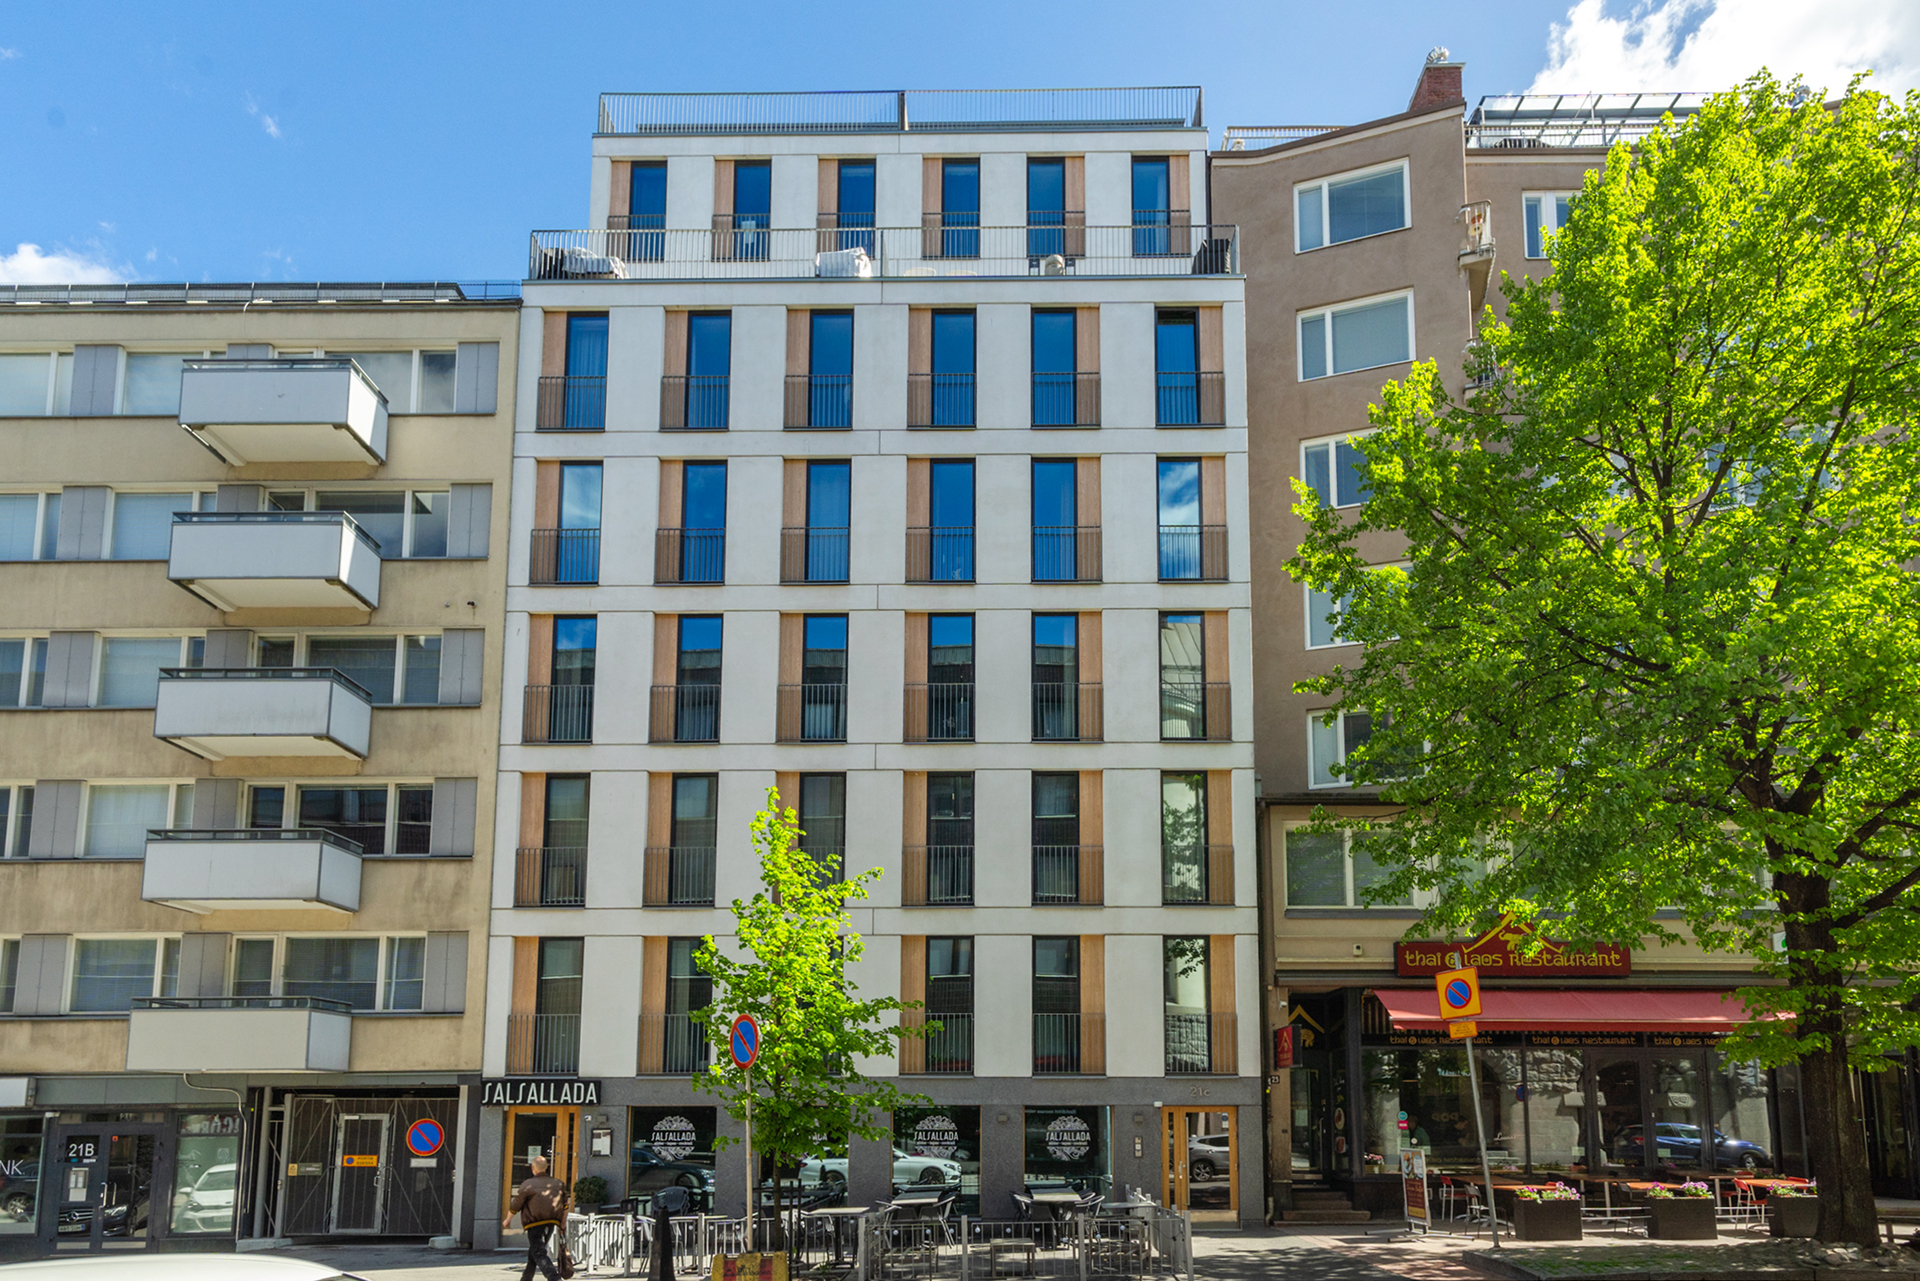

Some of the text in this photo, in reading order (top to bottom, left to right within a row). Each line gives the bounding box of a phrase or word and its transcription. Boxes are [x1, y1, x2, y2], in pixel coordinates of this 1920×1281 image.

[1404, 950, 1442, 966] thai
[1464, 954, 1503, 966] laos
[1390, 1036, 1408, 1044] thai
[1532, 1036, 1550, 1045] thai
[1653, 1036, 1672, 1045] thai
[482, 1082, 598, 1104] SALSALLADA
[651, 1132, 697, 1141] SALSALLADA
[913, 1131, 959, 1141] SALSALLADA
[1045, 1132, 1091, 1141] SALSALLADA
[68, 1143, 95, 1157] 21B
